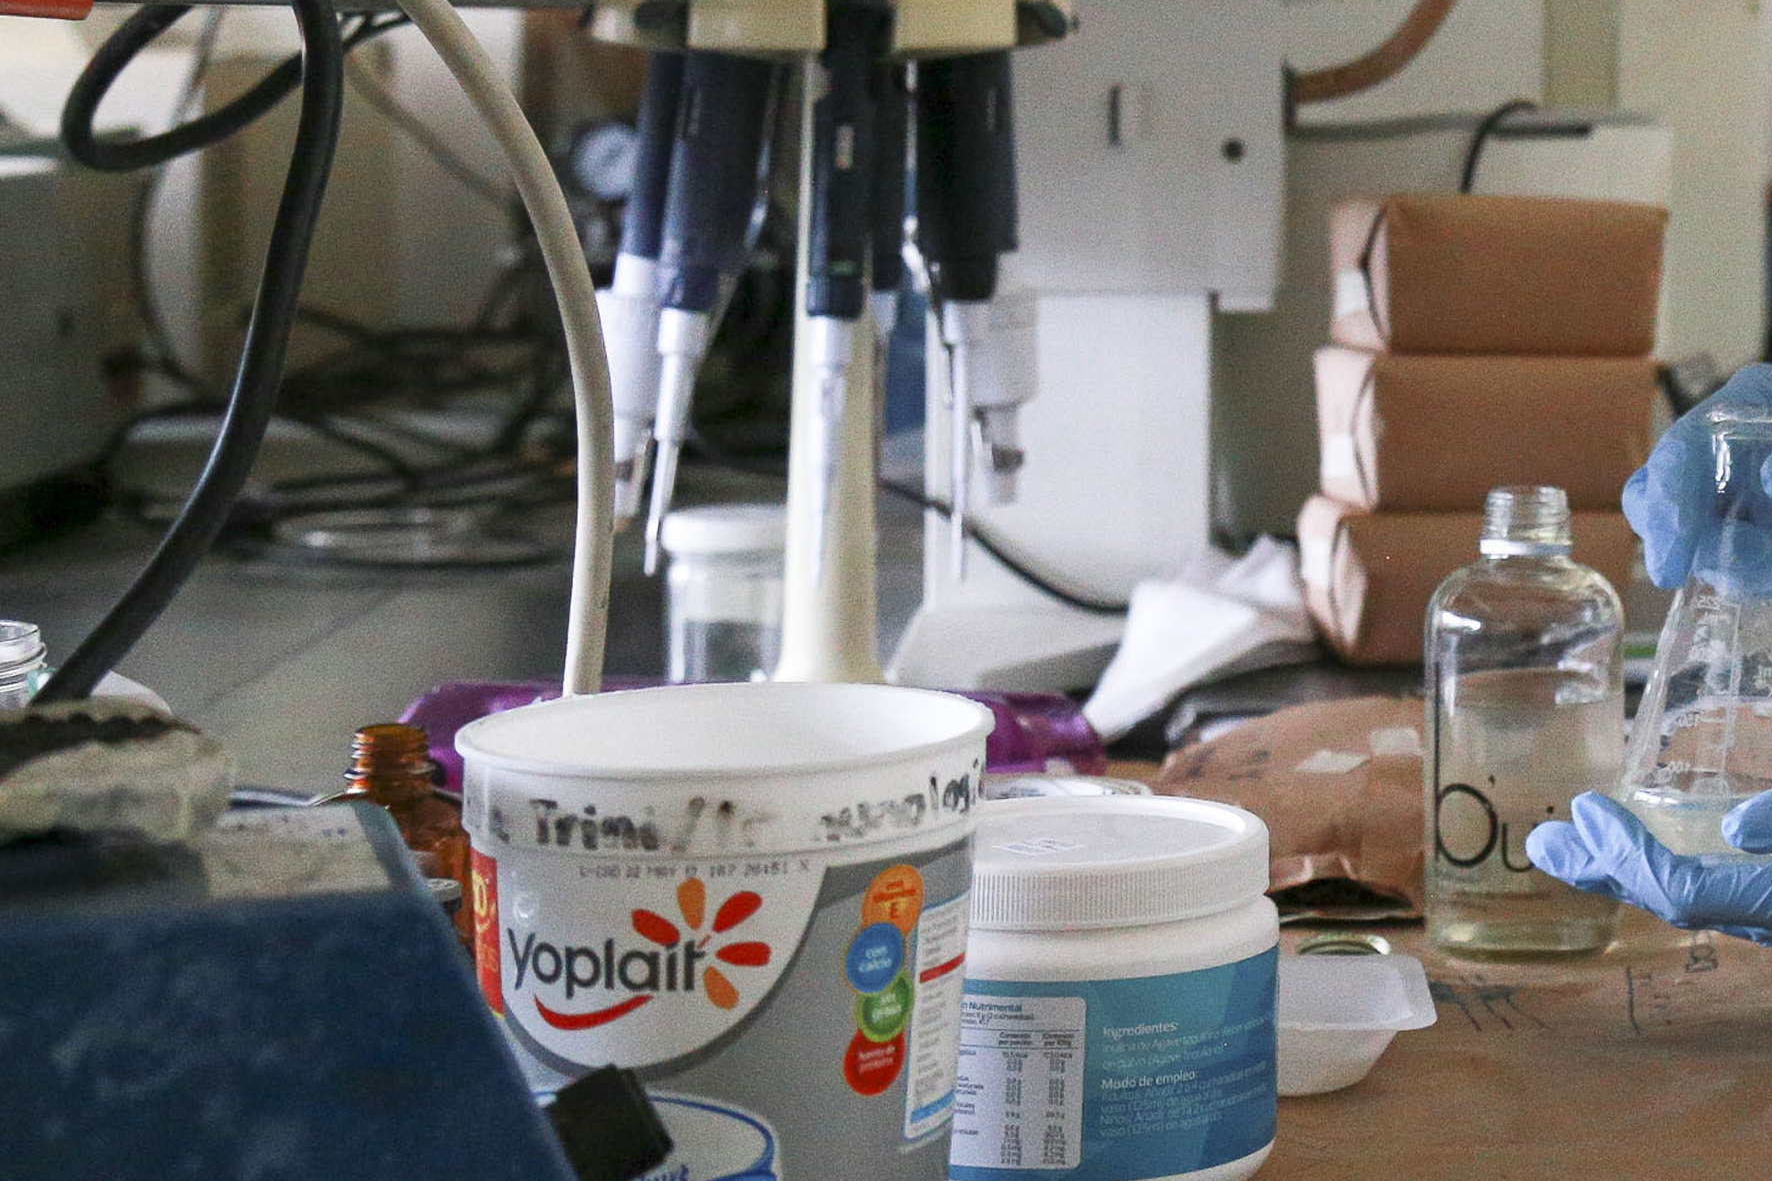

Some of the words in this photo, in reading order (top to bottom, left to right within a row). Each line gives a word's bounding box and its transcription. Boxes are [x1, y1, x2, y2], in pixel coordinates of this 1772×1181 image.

[507, 927, 705, 1000] Yoplait
[969, 1001, 1022, 1013] Nutrimental
[1101, 1077, 1137, 1090] Modo
[1138, 1075, 1154, 1087] de
[1155, 1069, 1198, 1086] empleo:
